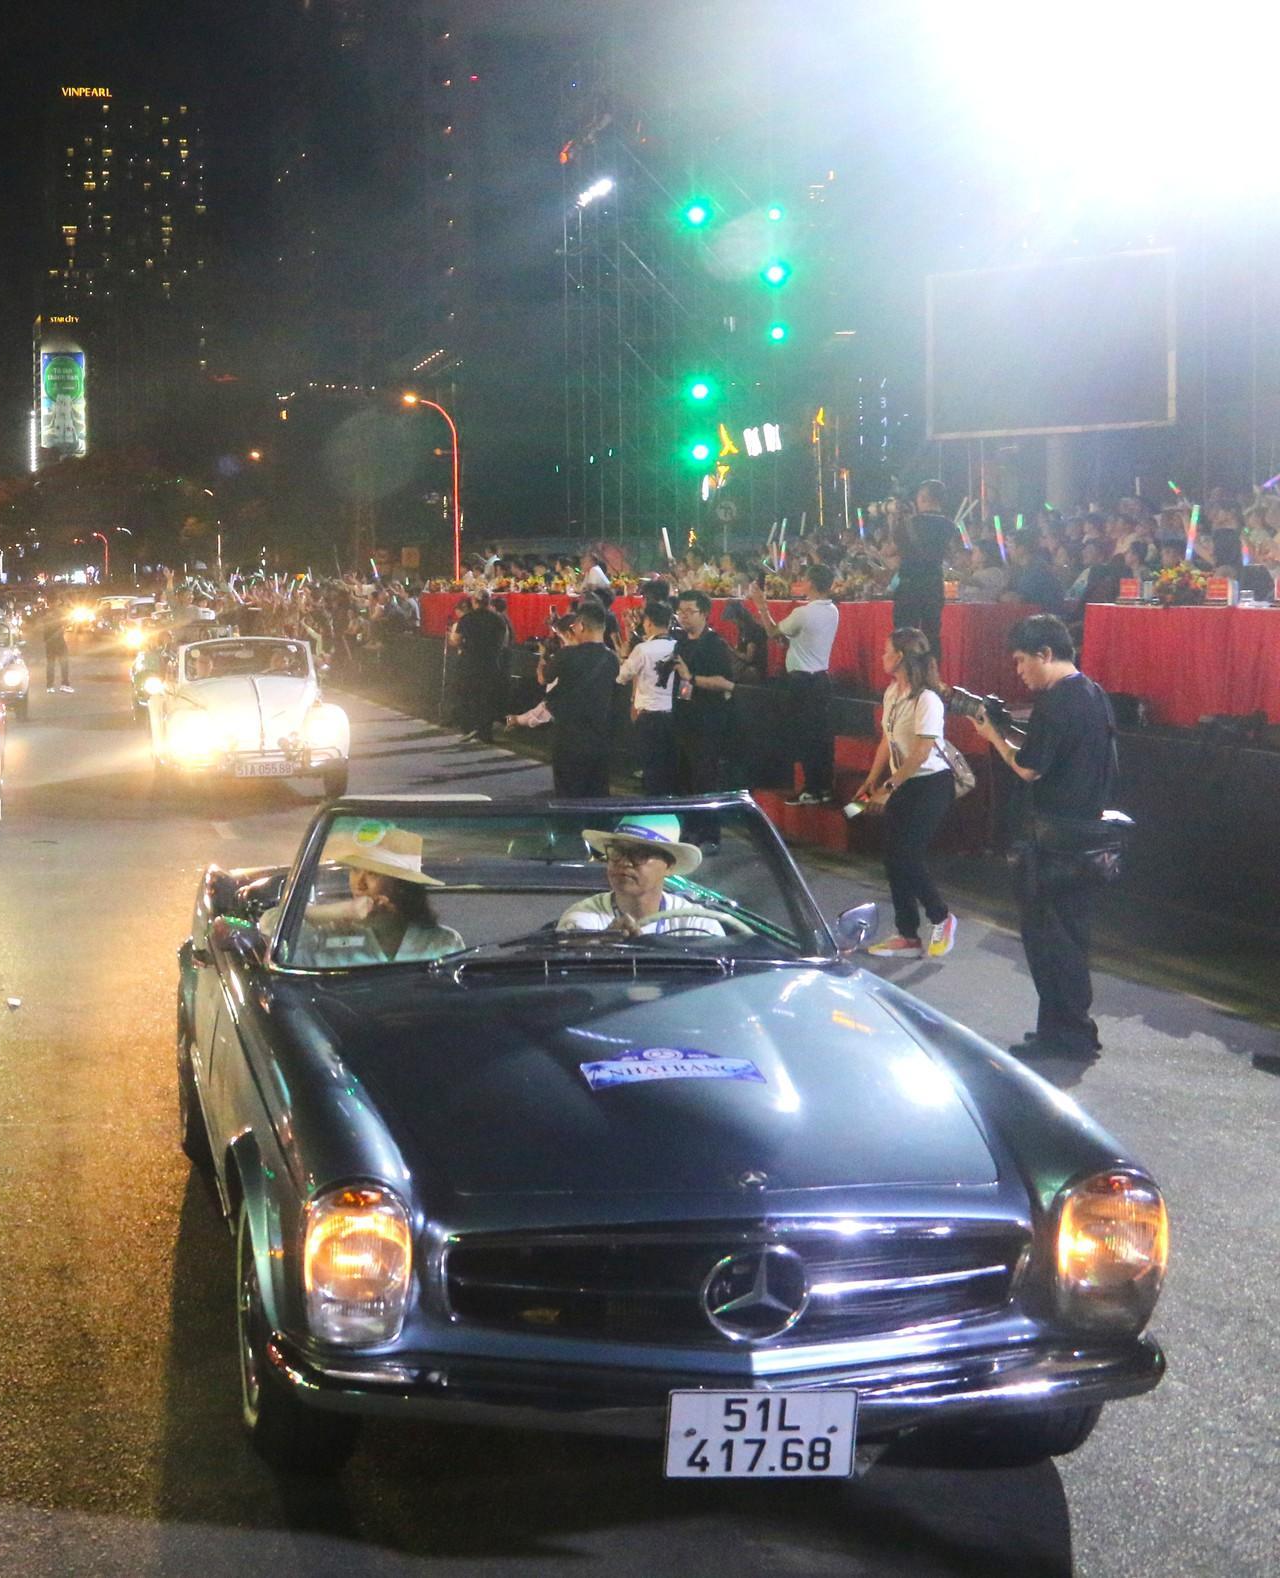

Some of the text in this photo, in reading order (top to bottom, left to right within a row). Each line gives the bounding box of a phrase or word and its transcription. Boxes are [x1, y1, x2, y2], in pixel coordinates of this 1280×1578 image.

[61, 87, 112, 97] VINPEARL
[723, 1398, 801, 1432] 51L
[686, 1437, 832, 1472] 417.68
